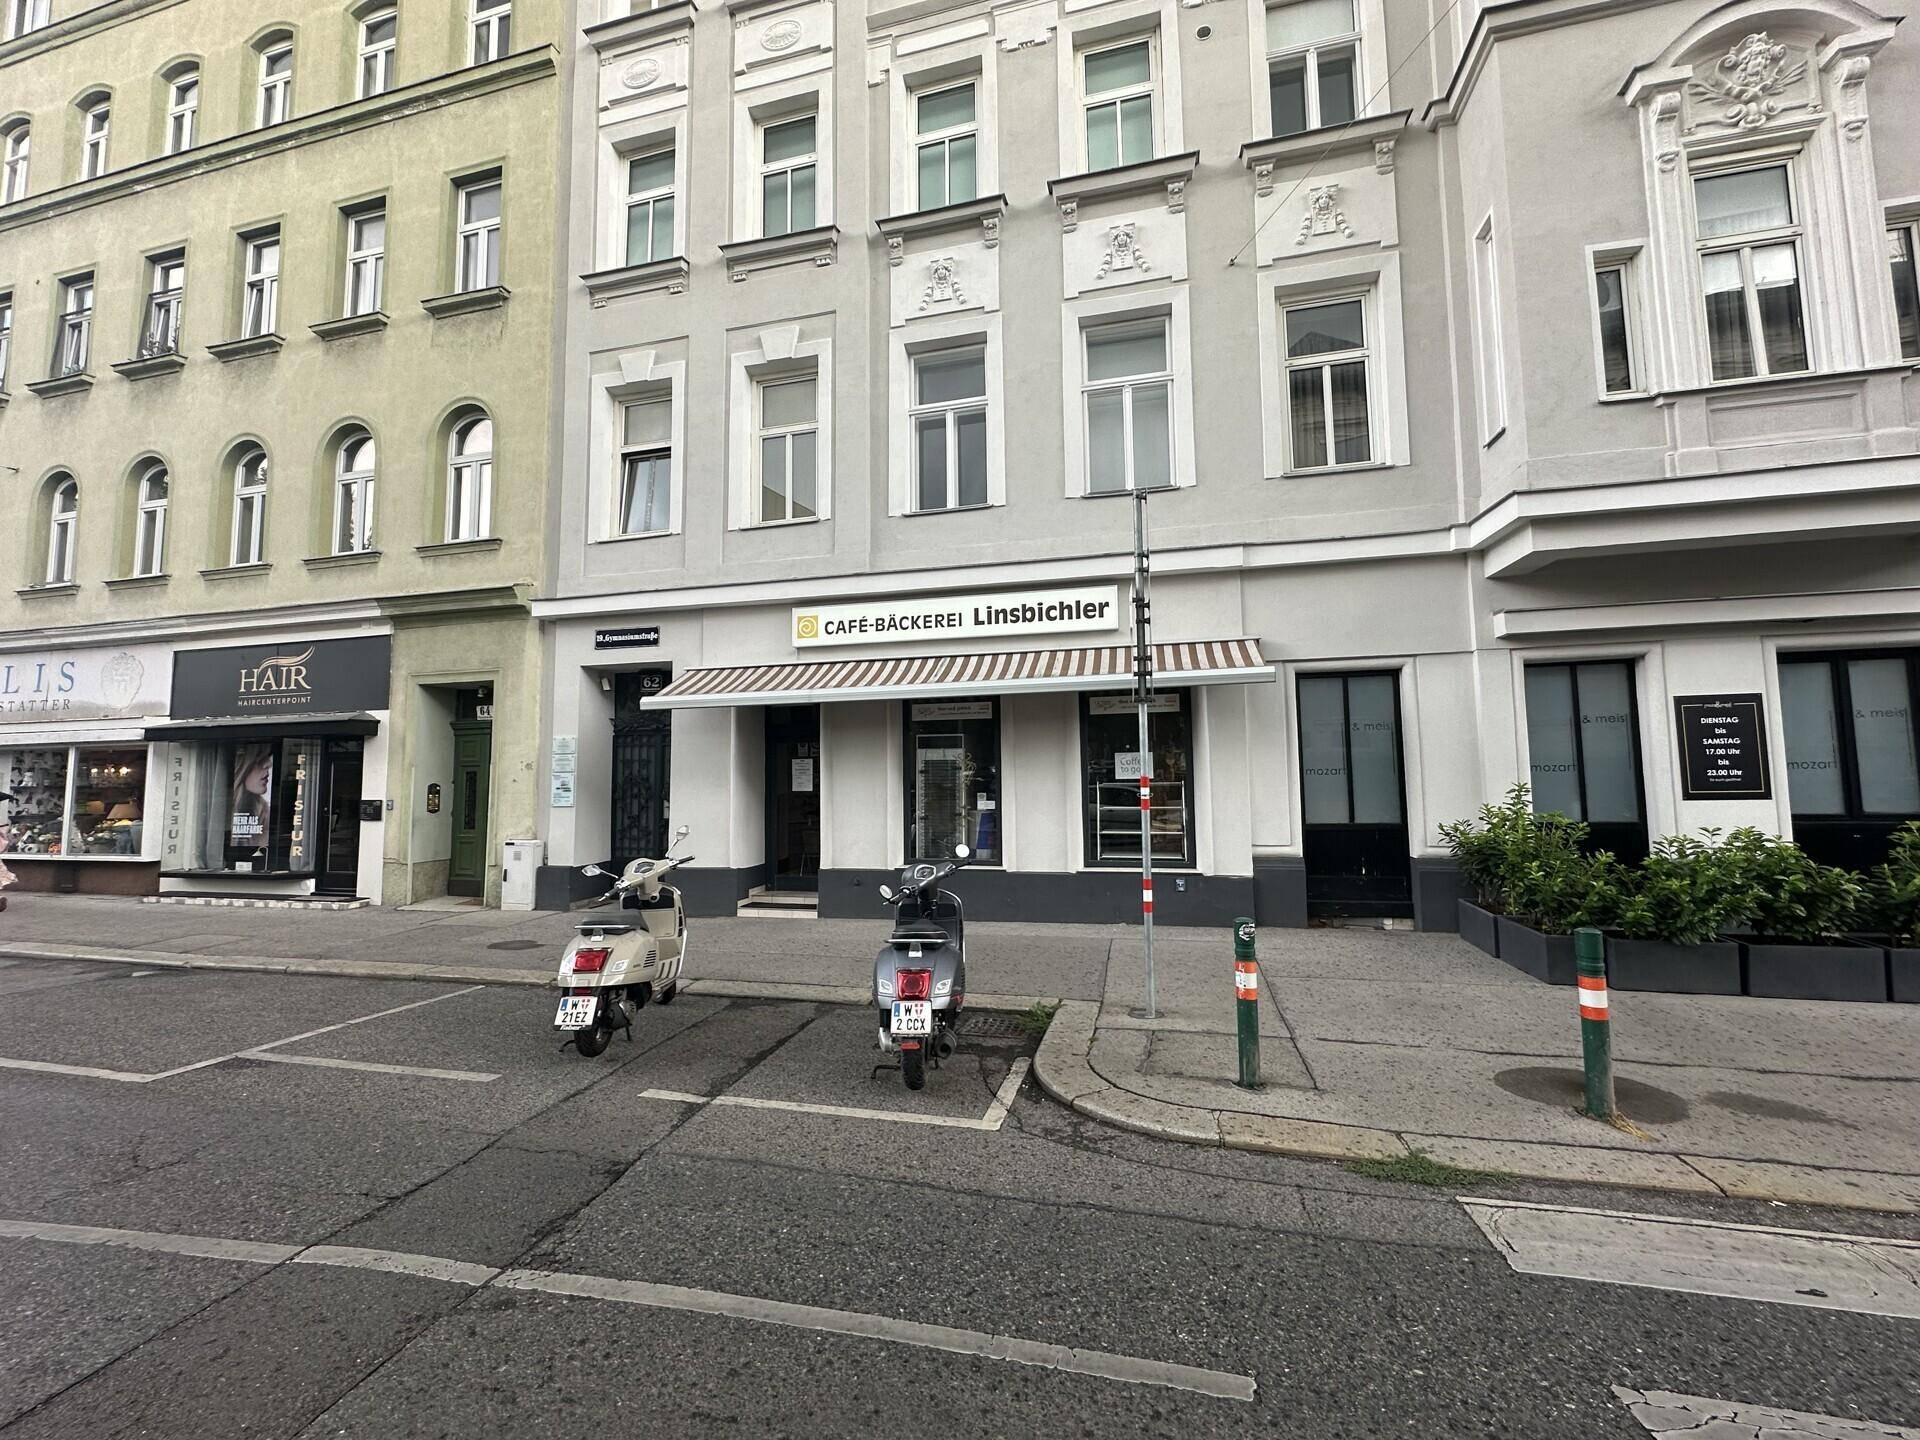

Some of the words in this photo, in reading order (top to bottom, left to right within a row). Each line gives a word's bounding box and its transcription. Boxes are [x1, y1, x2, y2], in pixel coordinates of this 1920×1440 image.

[824, 612, 963, 635] CAFÉ-BÄCKEREI
[974, 600, 1110, 626] Linsbichler
[2, 661, 76, 694] LIS
[239, 665, 312, 692] HAIR
[643, 676, 660, 688] 62
[238, 696, 312, 707] HAIRCENTERPOINT
[479, 706, 490, 716] 64
[1582, 714, 1591, 724] &
[1700, 716, 1739, 724] DIENSTAG
[1702, 737, 1741, 745] SAMSTAG
[1120, 766, 1129, 774] to
[1130, 766, 1141, 775] go
[1530, 763, 1577, 773] mozart
[290, 753, 306, 857] FRISEUR
[248, 816, 259, 825] ALS
[571, 999, 580, 1010] W
[904, 1004, 913, 1017] W
[896, 1018, 903, 1031] 2
[906, 1018, 926, 1031] CCX
